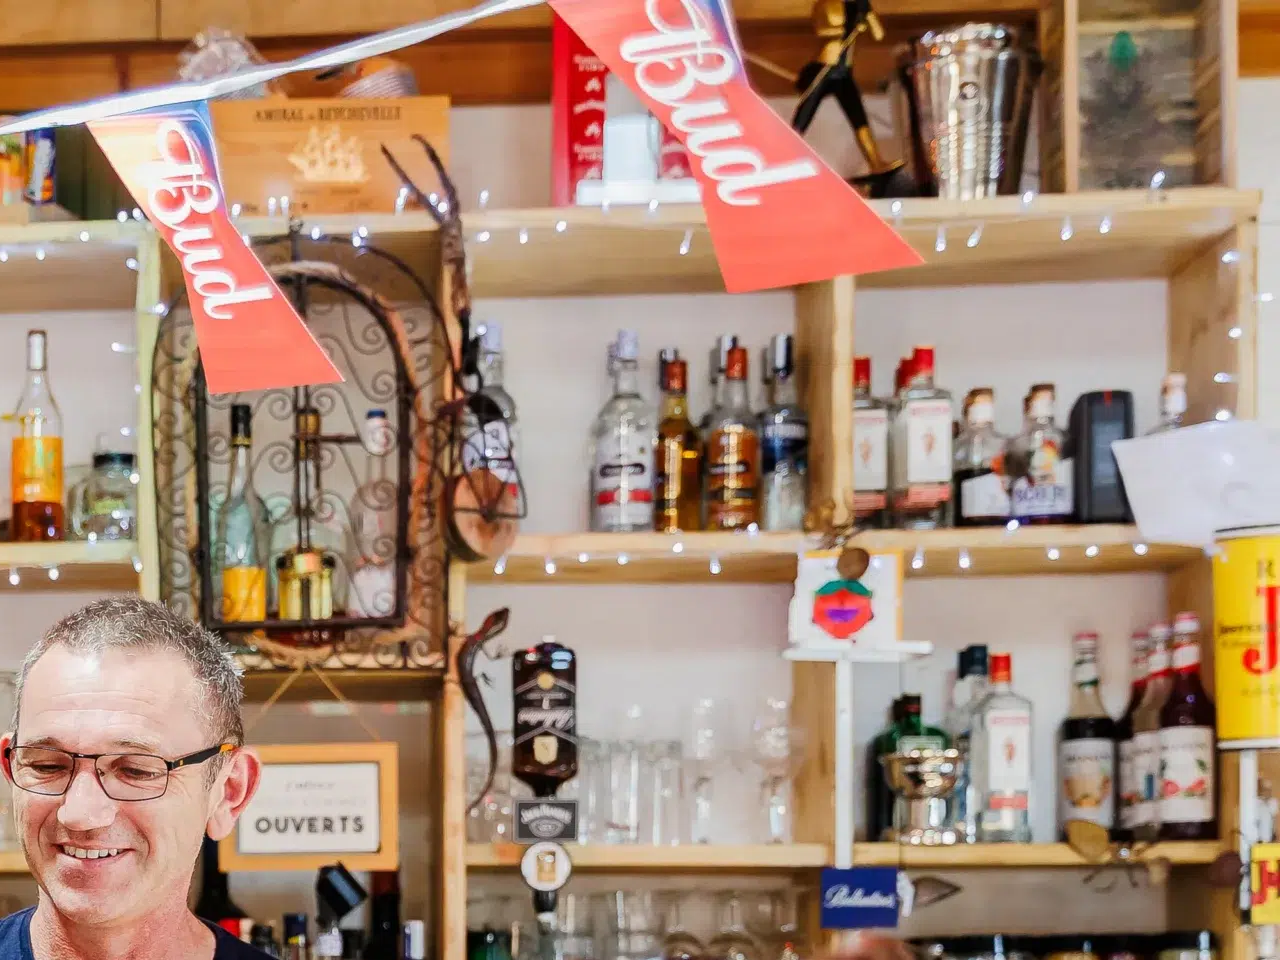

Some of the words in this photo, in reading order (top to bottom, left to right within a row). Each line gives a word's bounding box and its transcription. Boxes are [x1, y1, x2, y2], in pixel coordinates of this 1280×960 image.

[615, 0, 818, 208] Bud
[148, 121, 273, 320] Bud
[255, 815, 365, 834] OUVERTS
